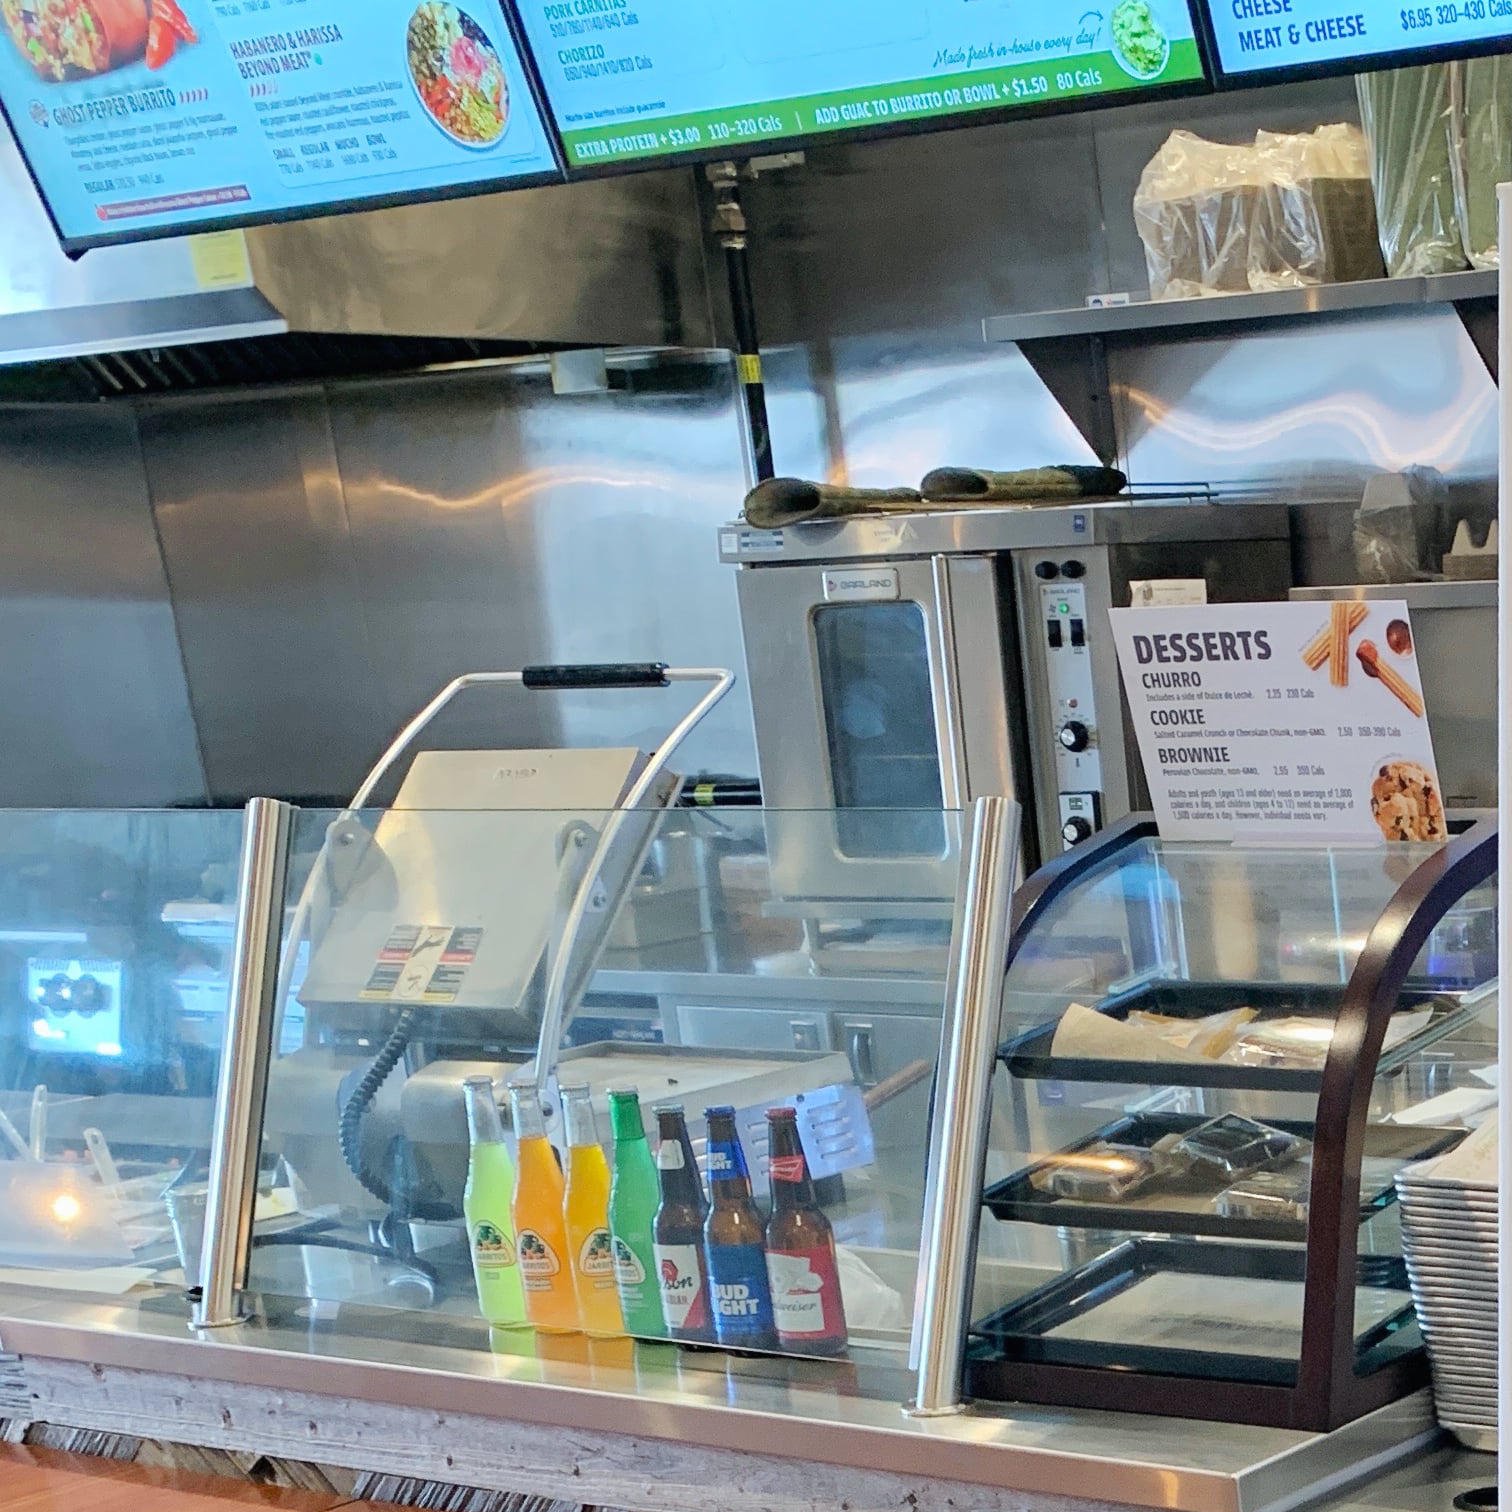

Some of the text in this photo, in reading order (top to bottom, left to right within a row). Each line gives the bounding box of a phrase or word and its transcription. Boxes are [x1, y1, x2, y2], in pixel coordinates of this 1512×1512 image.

[543, 3, 574, 21] PORK
[621, 11, 639, 25] Cals
[1232, 0, 1293, 20] CHEESE
[1400, 9, 1433, 32] $6.95
[1488, 0, 1512, 17] Cals
[229, 24, 344, 60] HABANERO & HARISSA
[1238, 14, 1367, 52] MEAT & CHEESE
[558, 44, 605, 65] CHORIZO
[932, 26, 1102, 69] Made fresh in-house every day!
[237, 57, 281, 80] BEYOND
[53, 88, 176, 126] GHOST PEPPER BURRITO
[815, 67, 1103, 125] ADD GUAC TO BURRITO OR BOWL + $1.50 80 Cals
[574, 141, 610, 159] EXTRA
[611, 133, 659, 155] PROTEIN
[668, 126, 700, 147] $3.00
[757, 114, 783, 132] Cals
[1132, 630, 1272, 664] DESSERTS
[1142, 671, 1202, 689] CHURRO
[1150, 709, 1206, 725] COOKIE
[1158, 747, 1231, 764] BROWNIE
